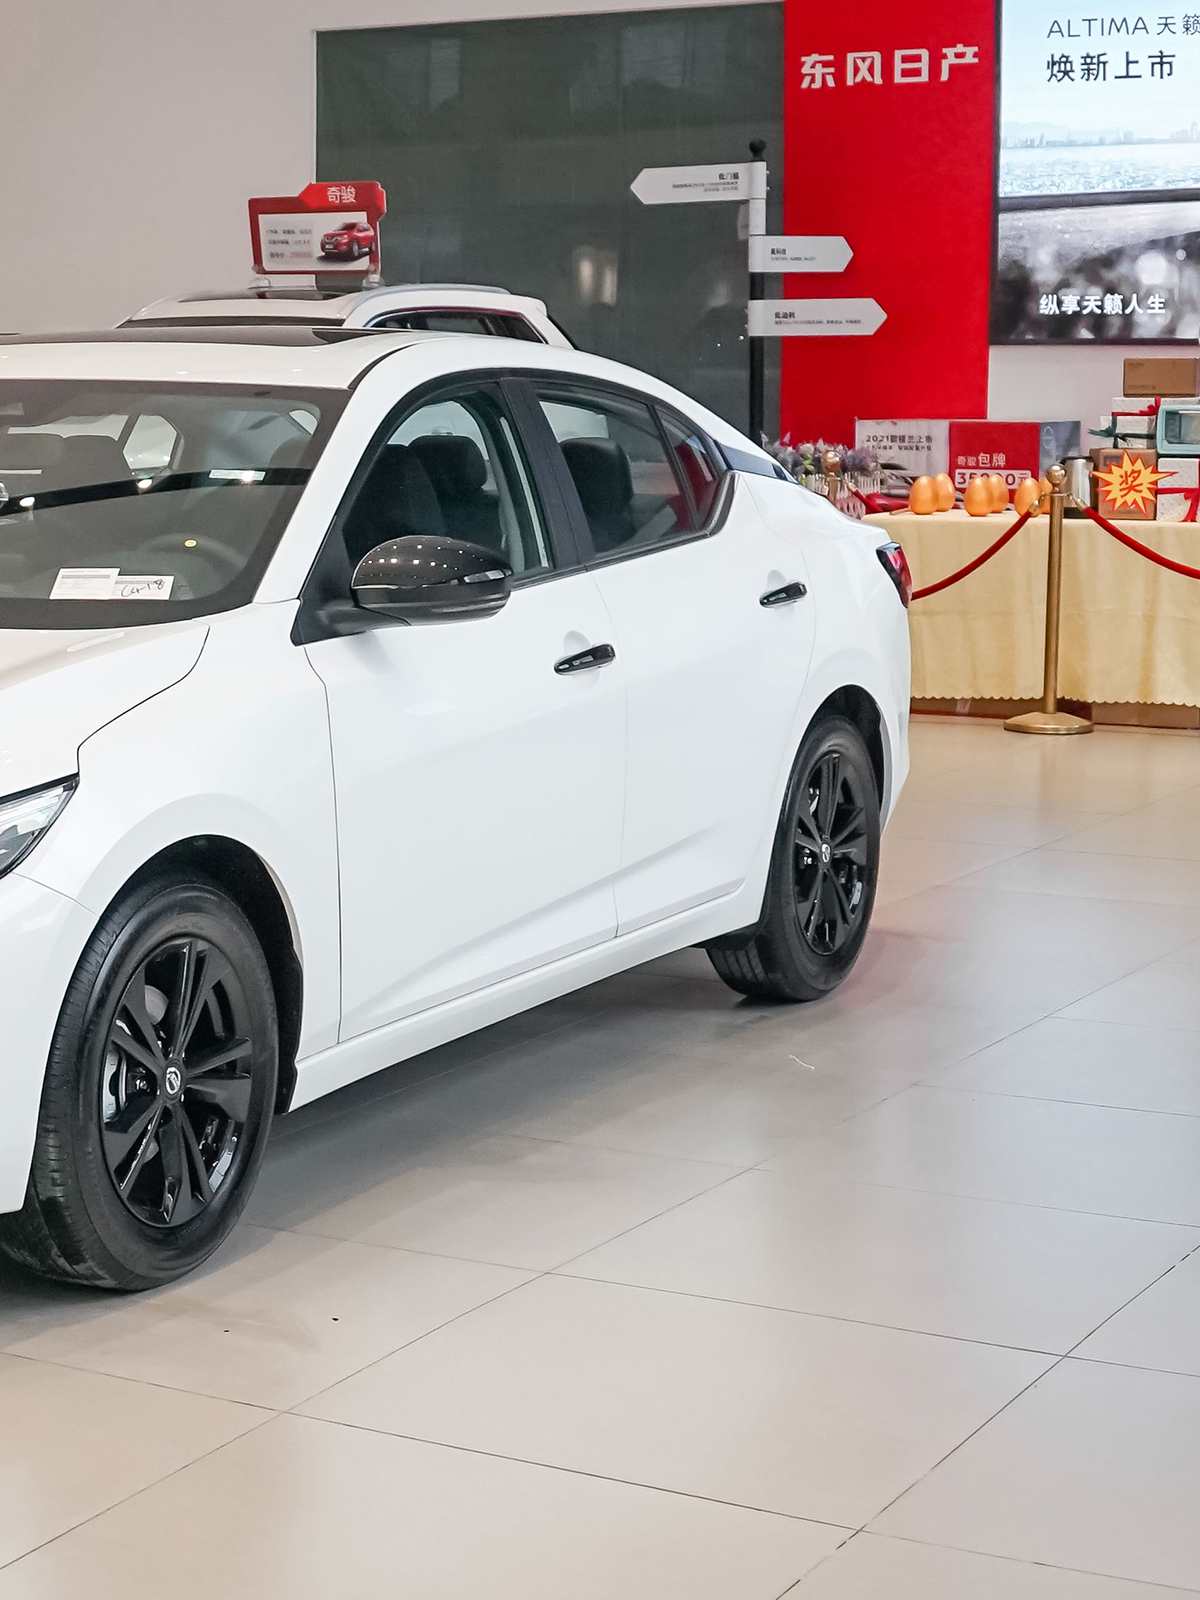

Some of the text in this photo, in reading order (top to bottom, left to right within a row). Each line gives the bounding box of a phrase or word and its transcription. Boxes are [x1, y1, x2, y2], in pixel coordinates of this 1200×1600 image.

[1046, 16, 1150, 39] ALTIMA
[800, 43, 980, 89] 东风日产
[1046, 50, 1176, 83] 焕新上市
[327, 185, 357, 204] 奇骏
[1039, 292, 1167, 316] 纵享天籁人生
[1119, 469, 1144, 498] 奖
